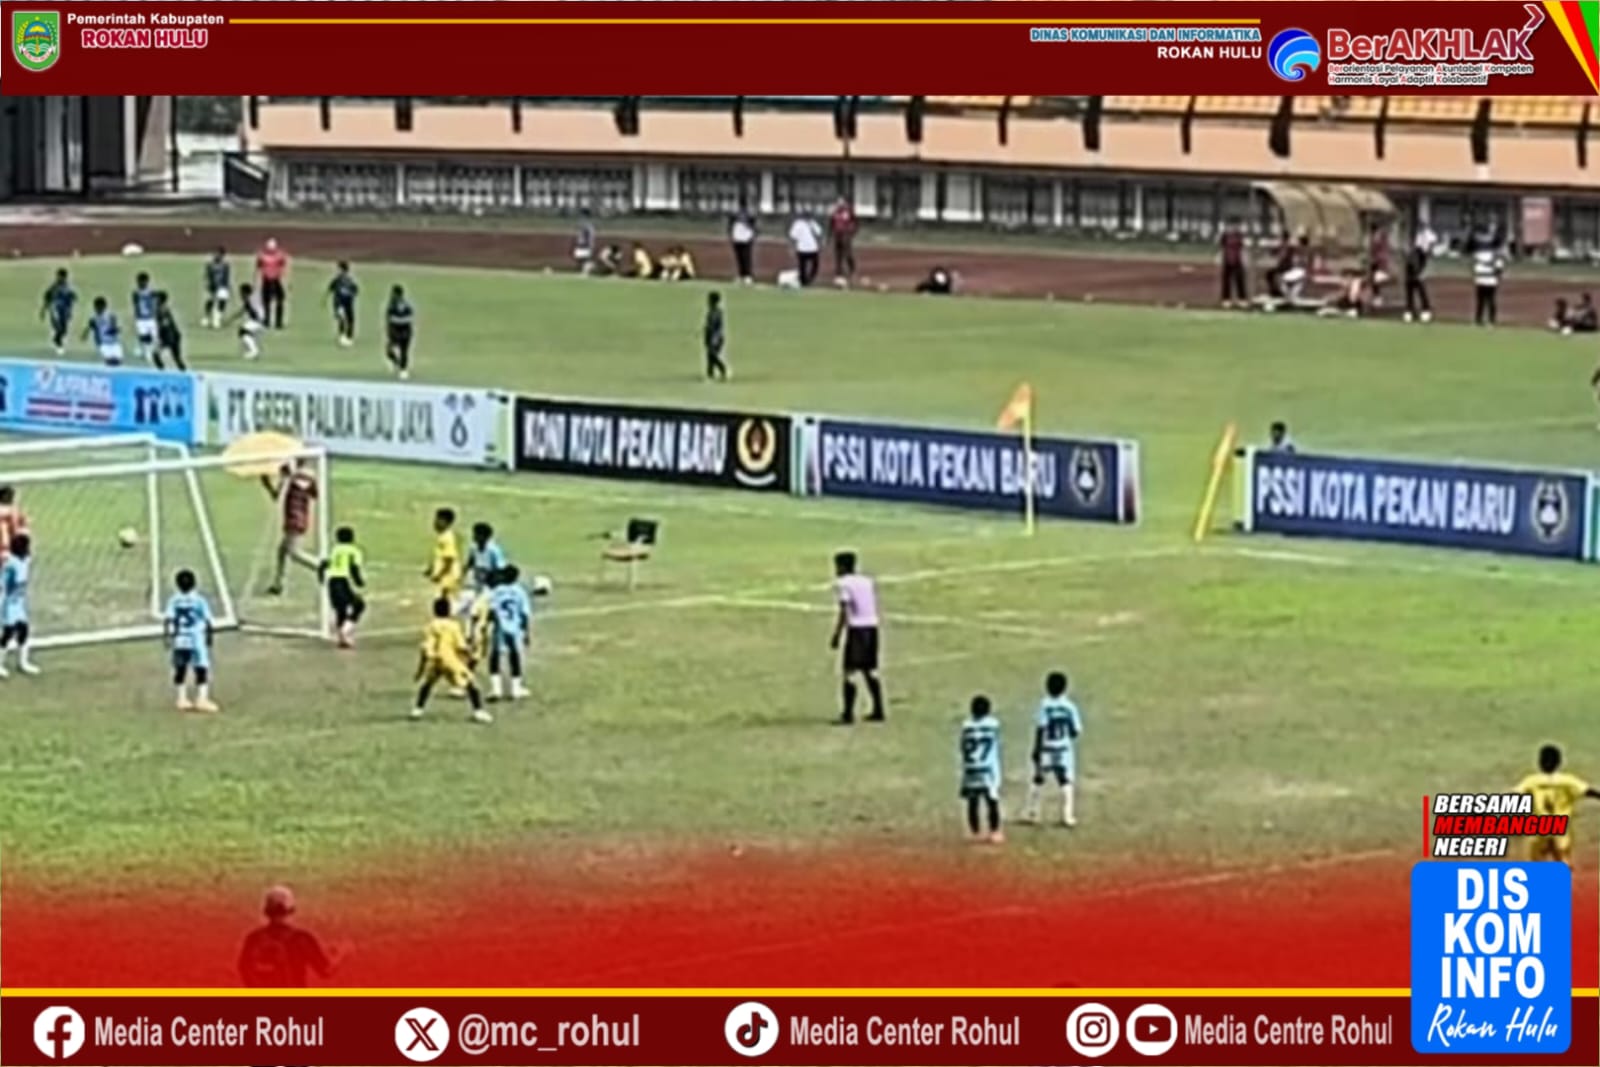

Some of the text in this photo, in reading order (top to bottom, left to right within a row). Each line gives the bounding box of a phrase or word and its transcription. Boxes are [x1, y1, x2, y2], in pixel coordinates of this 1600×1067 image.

[522, 410, 728, 475] KONI KOTA PEKAN BARU
[822, 433, 1056, 499] PSSI KOTA PEKAN BARU
[1257, 465, 1516, 535] PSSI KOTA PEKAN BARU
